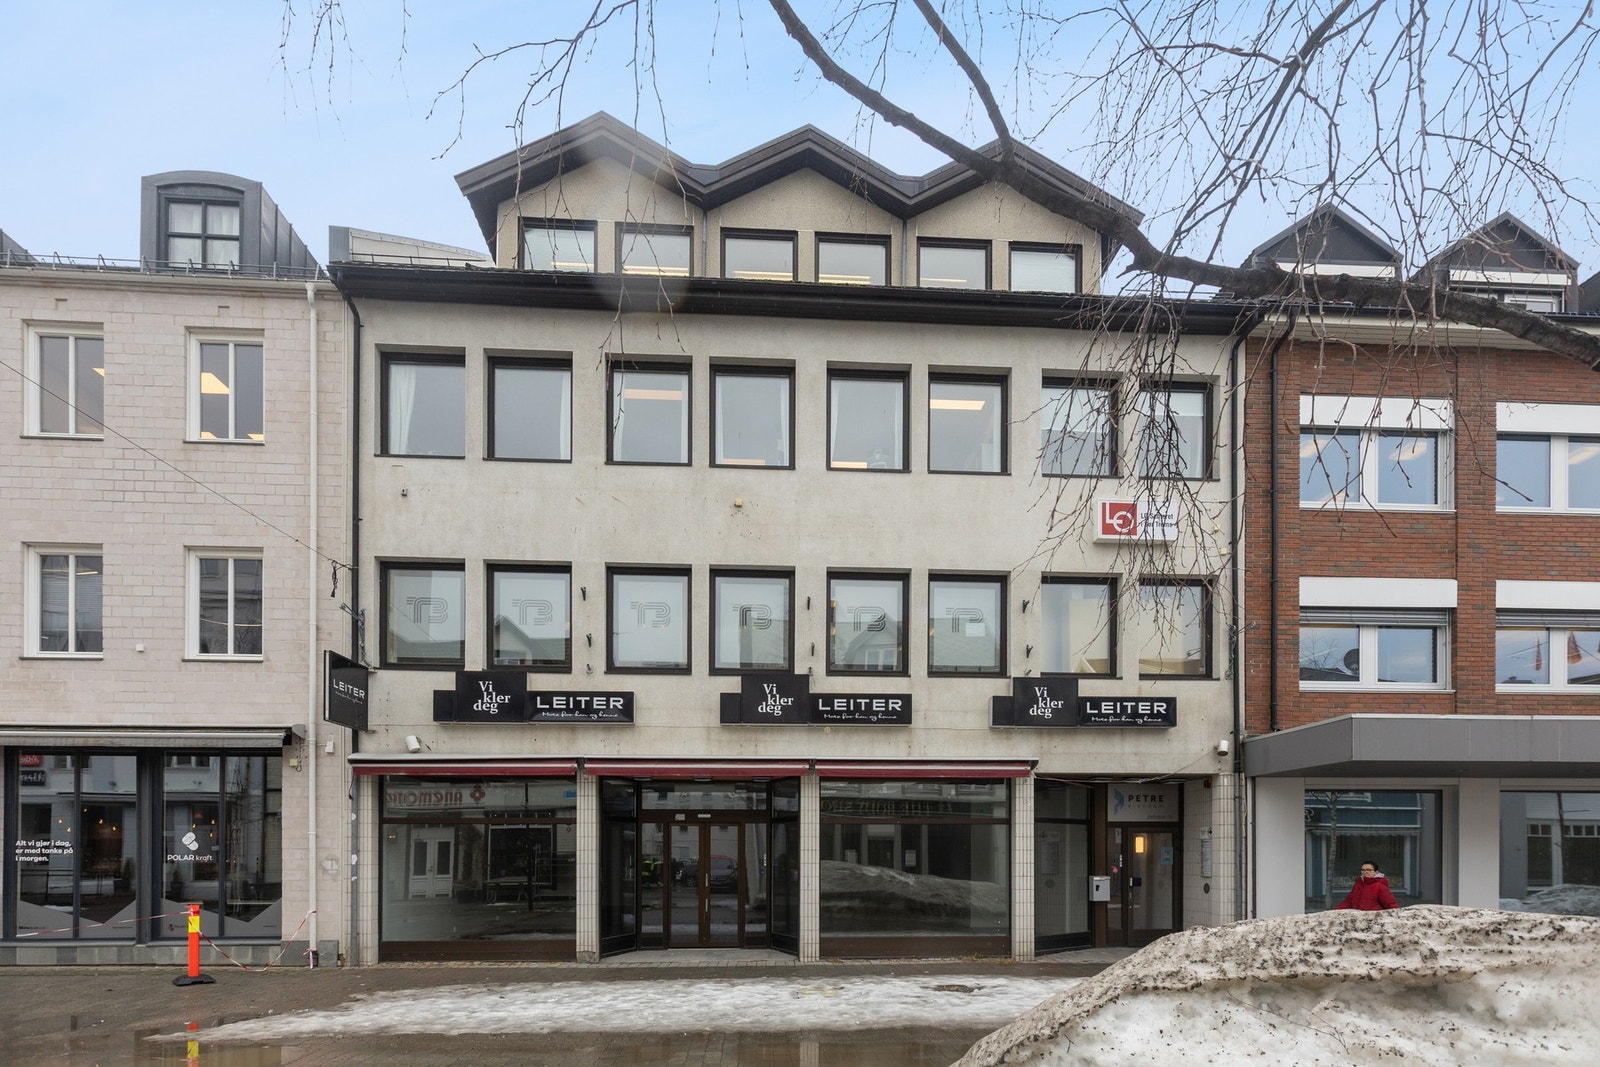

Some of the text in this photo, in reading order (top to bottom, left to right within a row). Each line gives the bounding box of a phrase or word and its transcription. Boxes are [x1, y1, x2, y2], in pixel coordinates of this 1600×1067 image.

[1106, 502, 1134, 533] LO
[333, 678, 366, 700] LEITER
[478, 680, 493, 692] Vi
[762, 683, 777, 695] Vi
[1034, 686, 1048, 698] Vi
[483, 692, 511, 704] kler
[536, 696, 624, 709] LEITER
[767, 694, 794, 706] kler
[1038, 697, 1064, 709] kler
[473, 700, 498, 714] deg
[758, 702, 782, 716] deg
[818, 698, 902, 711] LEITER
[1086, 702, 1167, 714] LEITER
[1029, 705, 1052, 719] deg
[1128, 794, 1164, 802] PETRE
[35, 840, 50, 848] gjør
[55, 840, 72, 848] dag,
